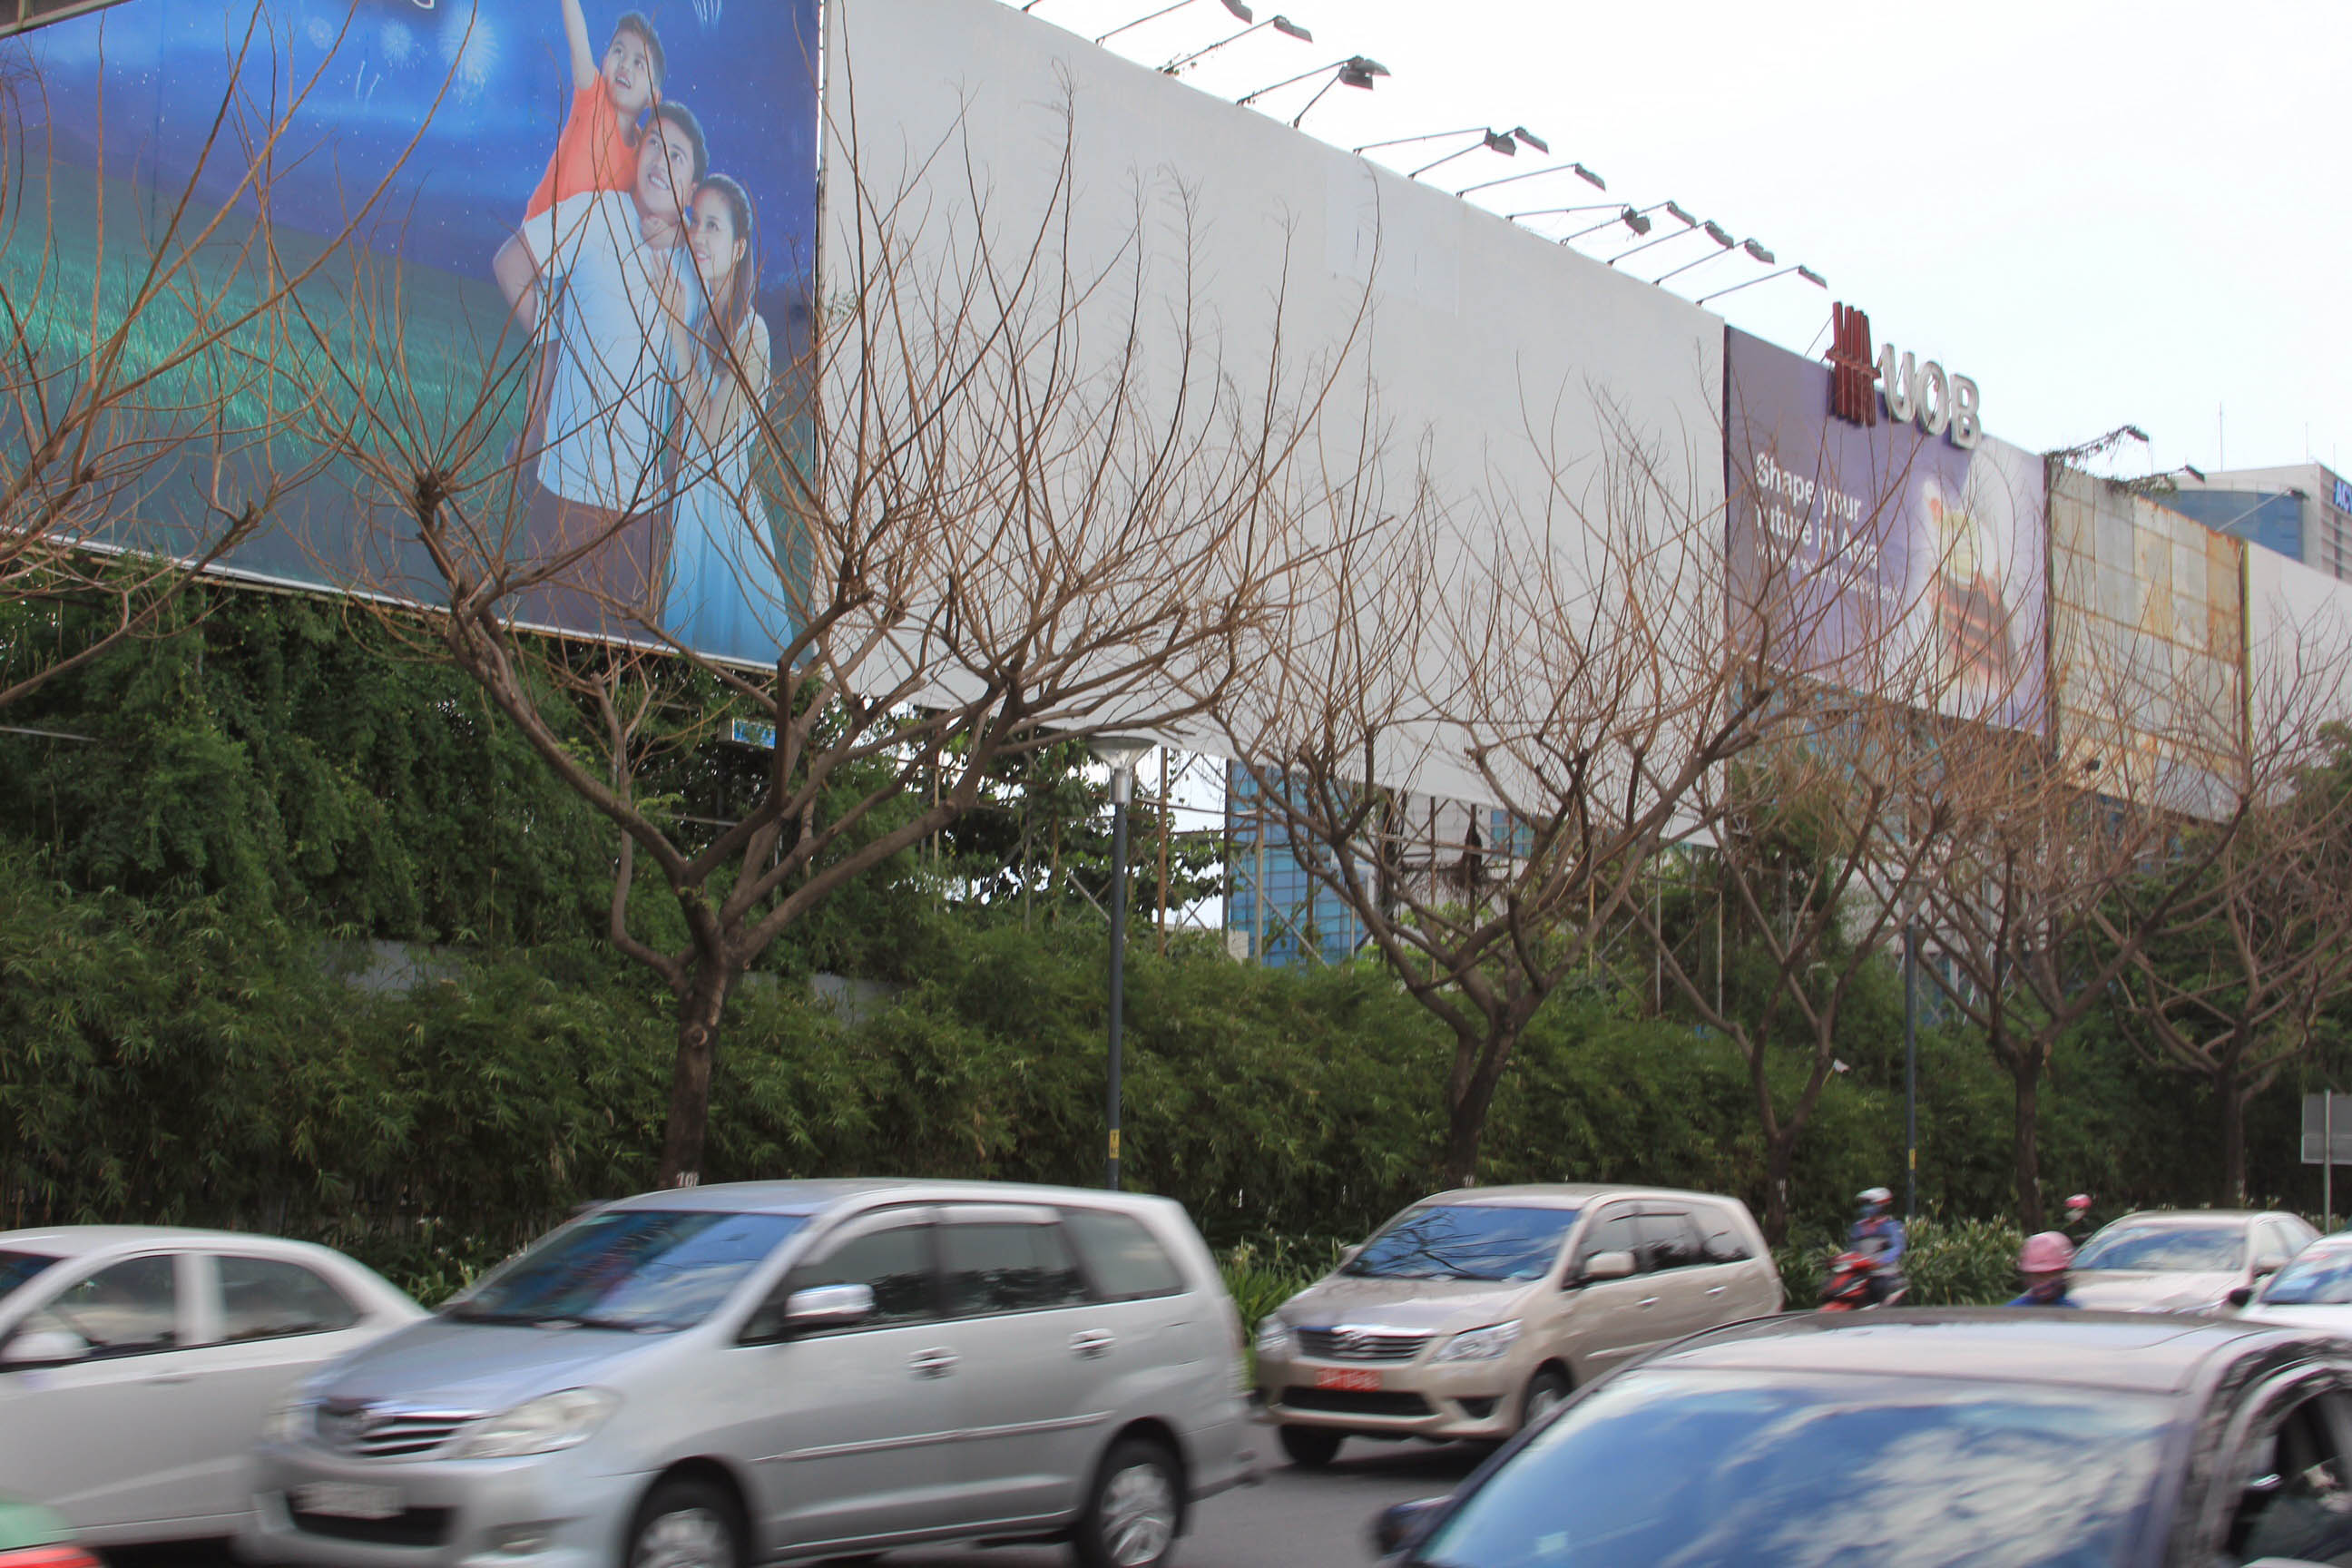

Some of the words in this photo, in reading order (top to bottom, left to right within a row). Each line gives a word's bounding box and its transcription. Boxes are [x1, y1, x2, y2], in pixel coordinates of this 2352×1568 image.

[1881, 343, 1982, 450] UOB
[1755, 452, 1816, 507] Shape
[1820, 484, 1861, 523] your
[2335, 478, 2352, 515] AC
